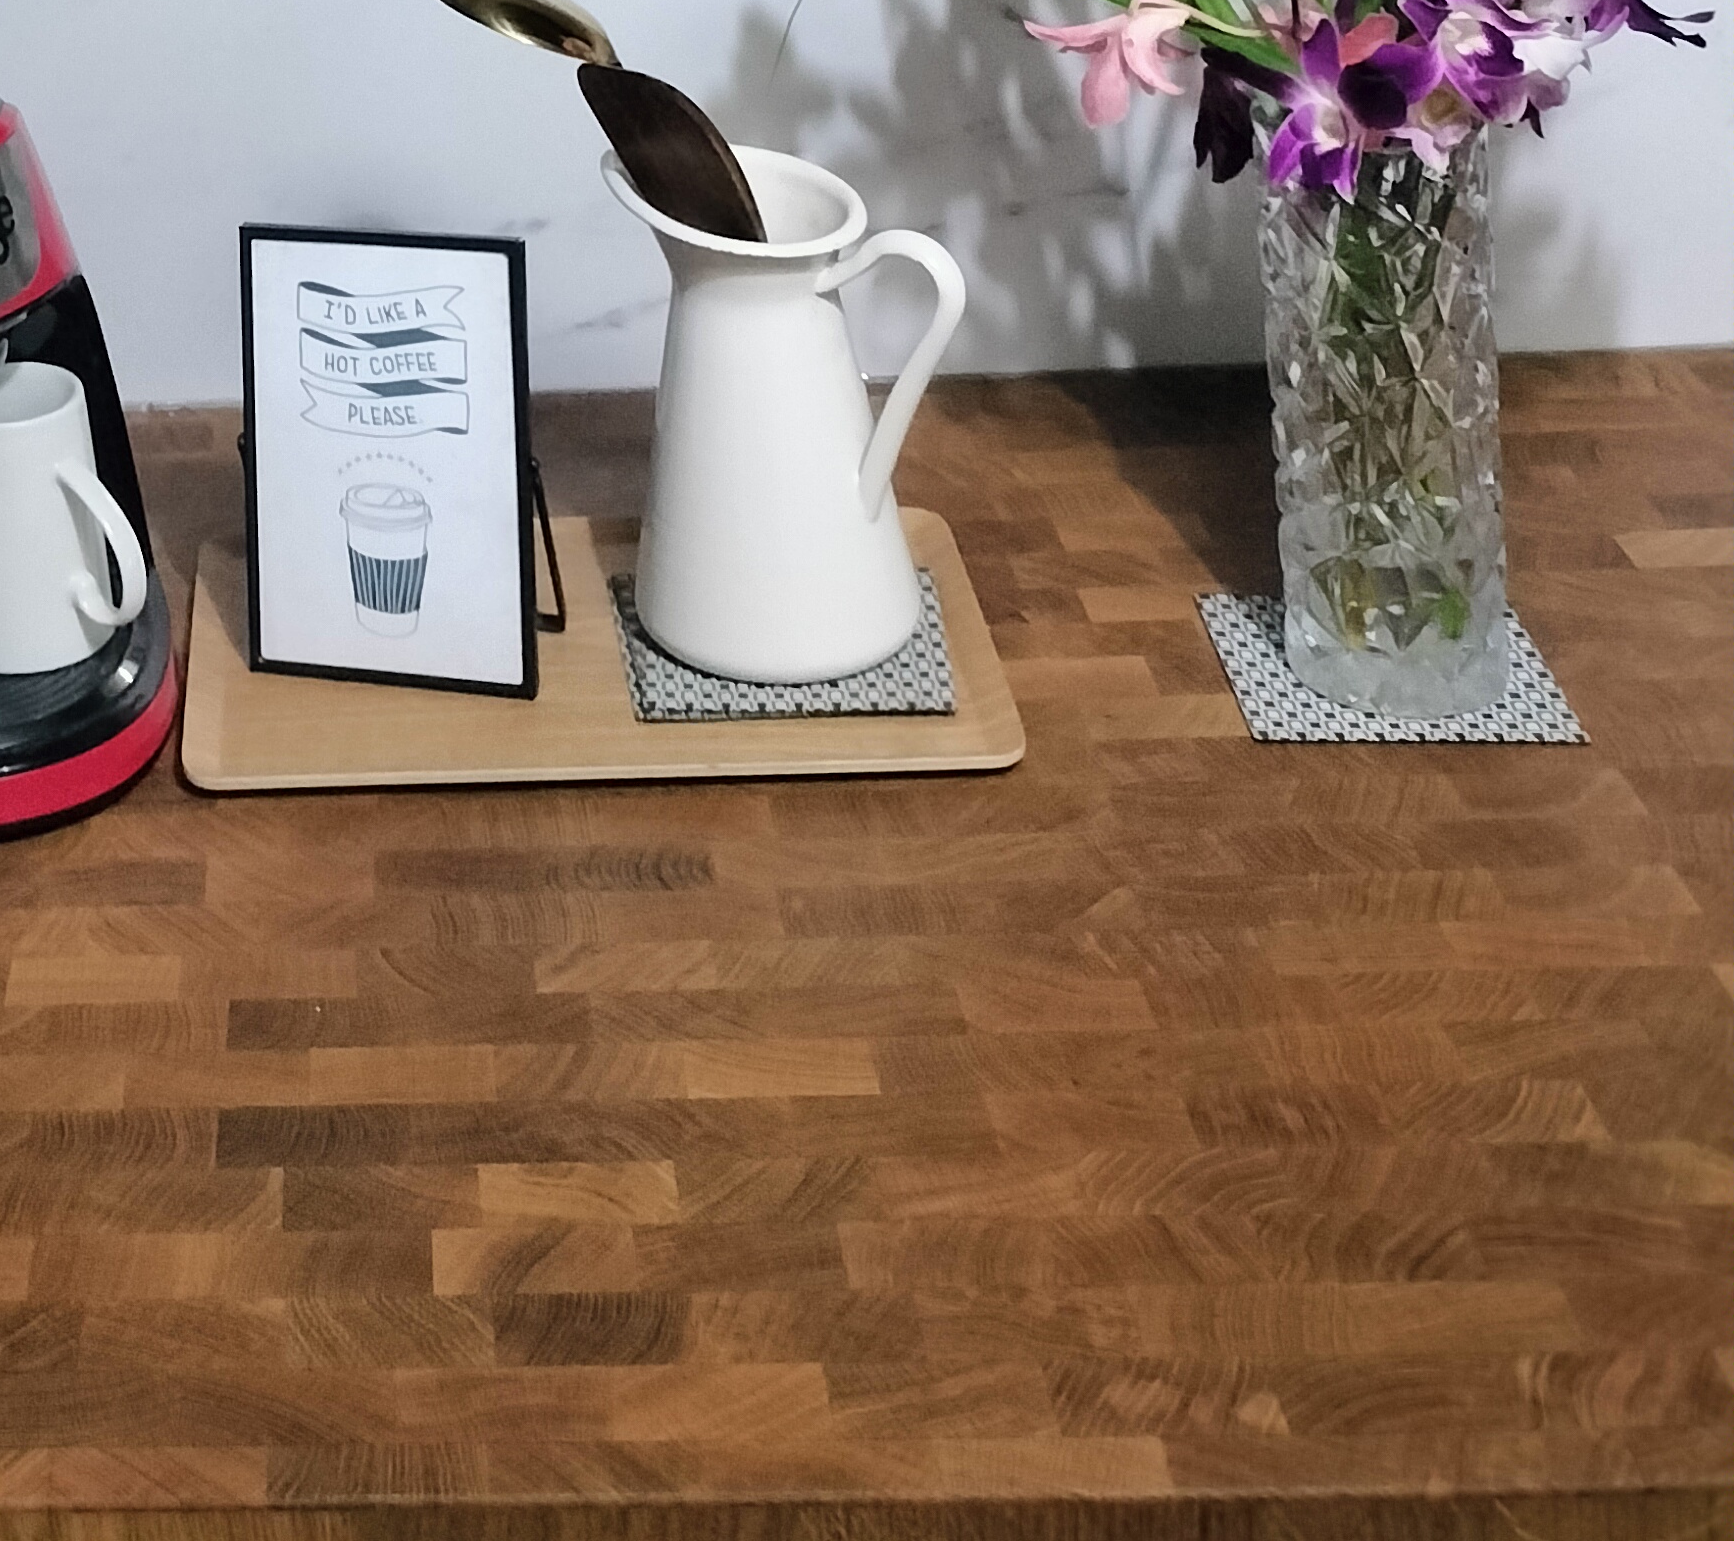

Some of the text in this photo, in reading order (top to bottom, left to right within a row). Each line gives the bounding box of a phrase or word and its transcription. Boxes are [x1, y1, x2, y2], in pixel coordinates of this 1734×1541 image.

[324, 298, 427, 325] I'D LIKE A
[324, 352, 438, 377] HOT COFFEE
